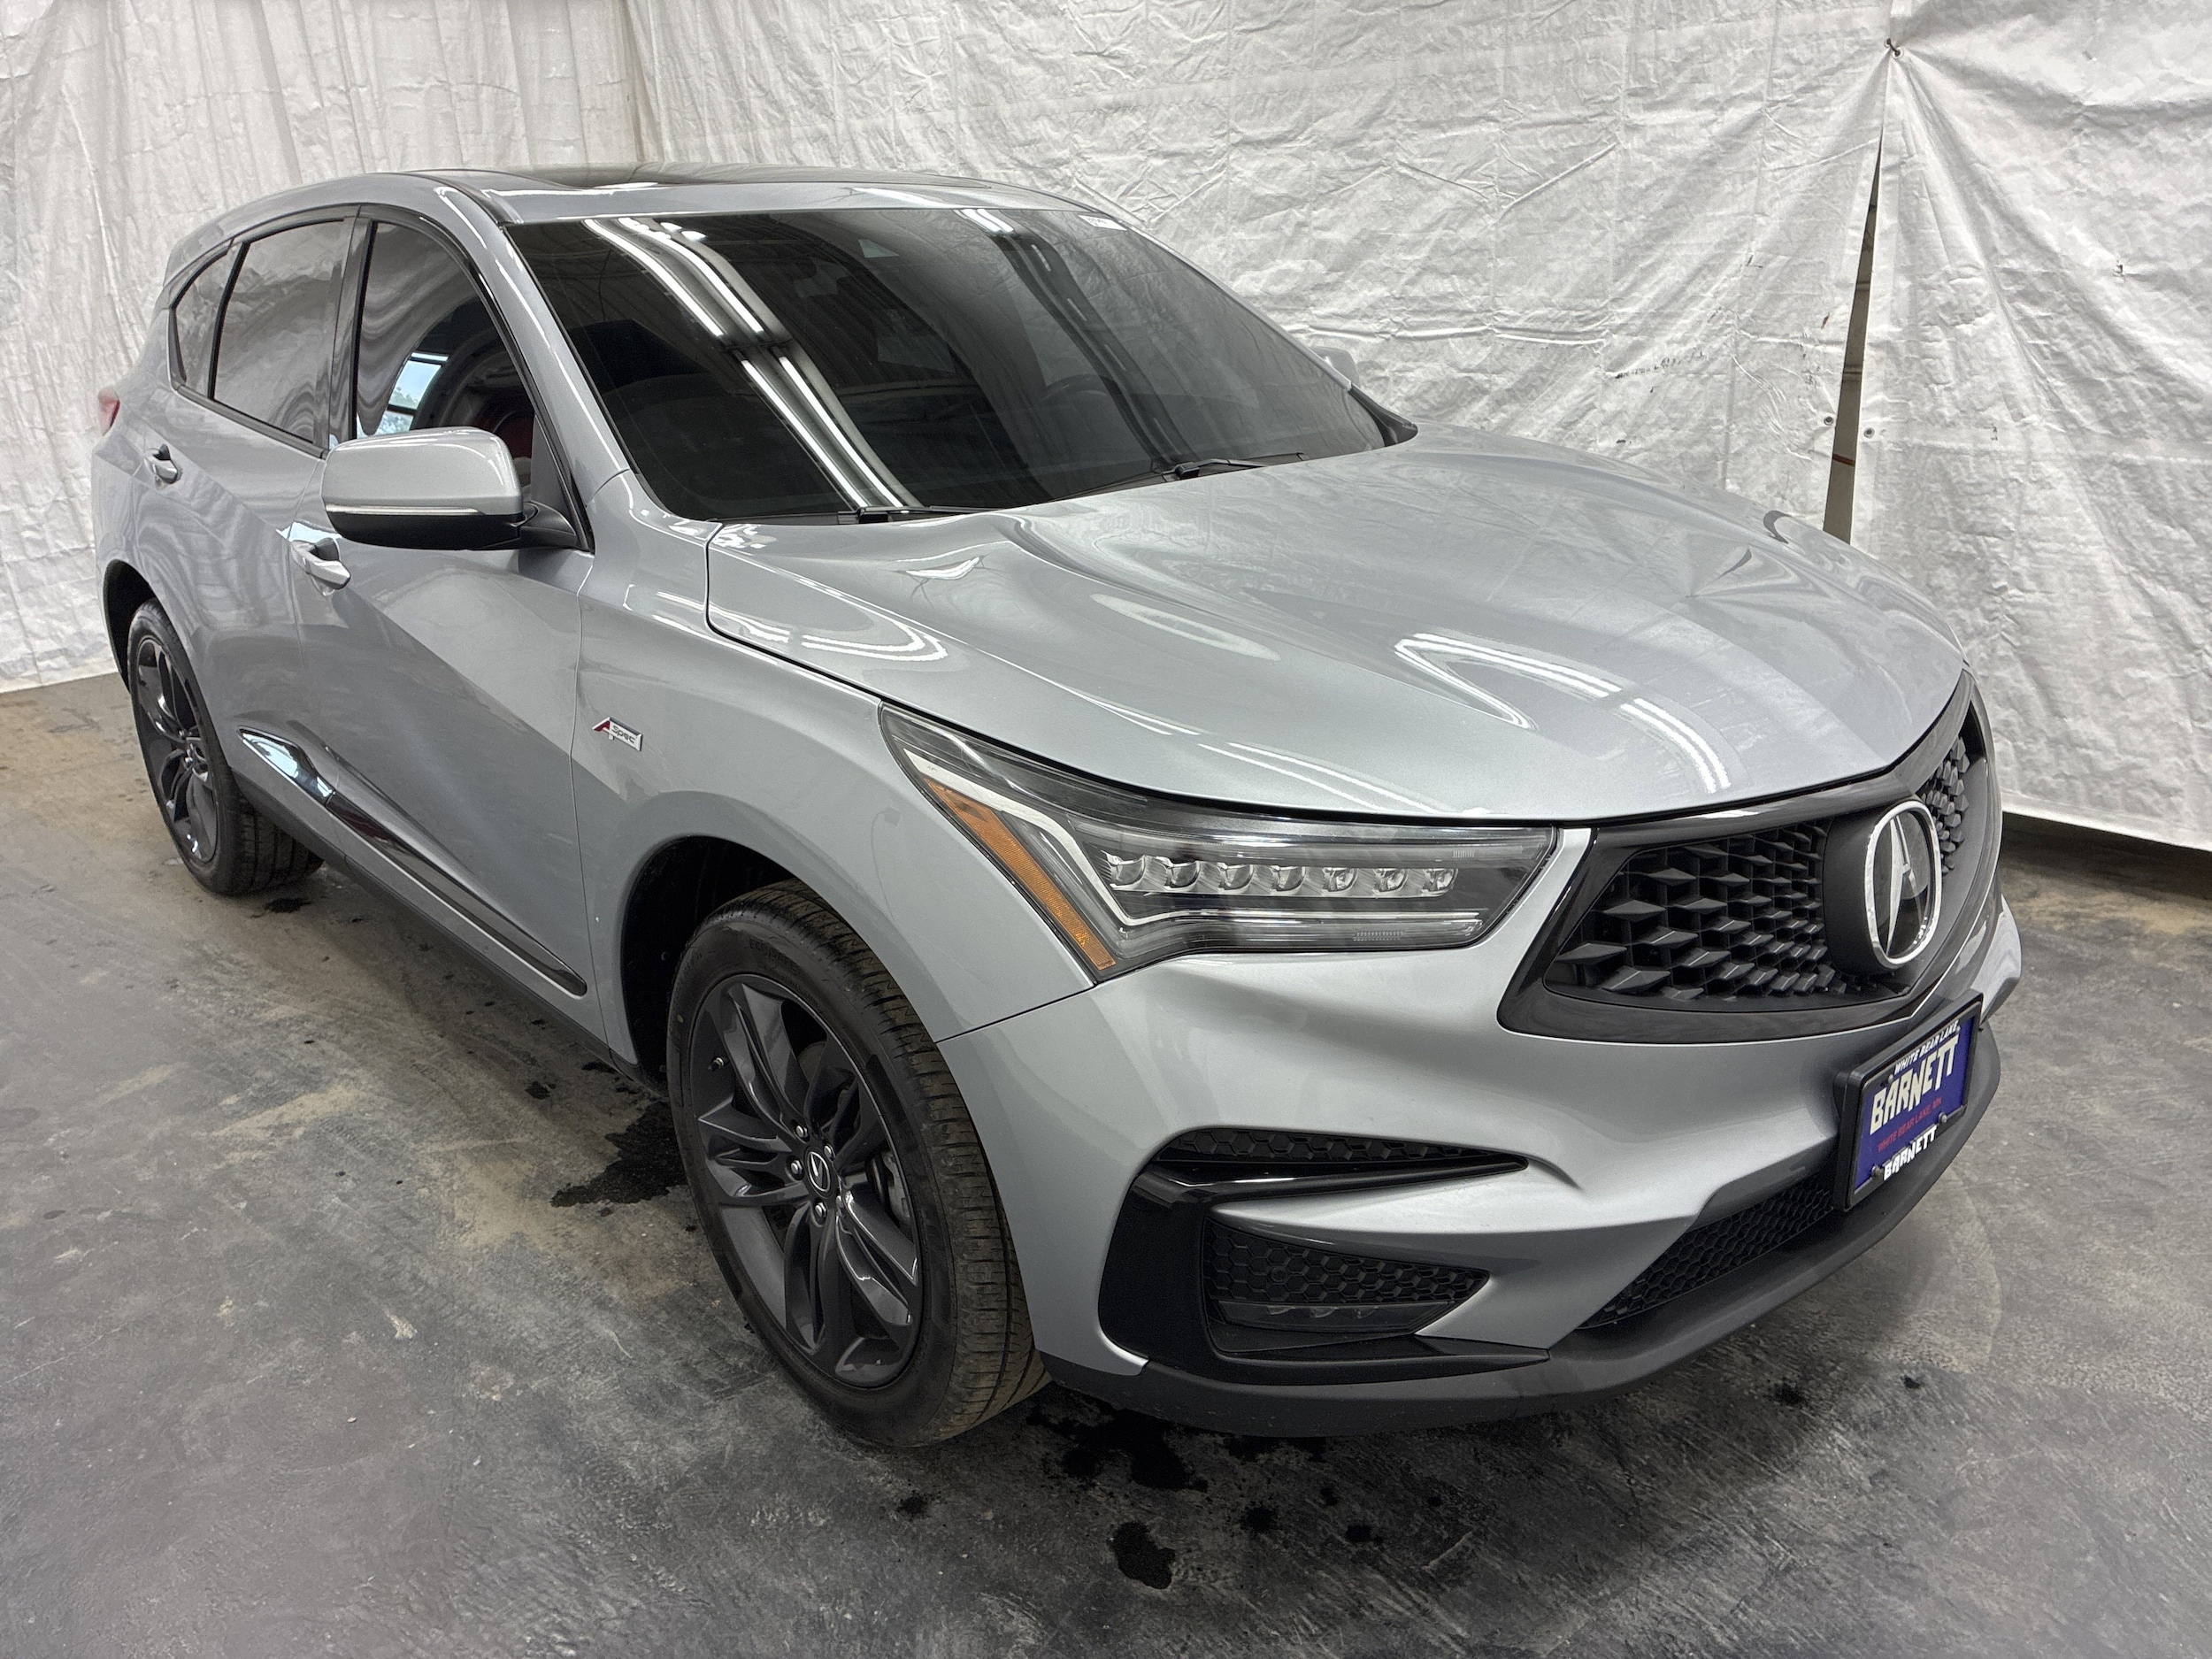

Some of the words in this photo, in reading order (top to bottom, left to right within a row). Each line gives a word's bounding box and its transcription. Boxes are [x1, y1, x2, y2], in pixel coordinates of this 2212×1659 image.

[1894, 1048, 1920, 1075] WHITE
[1919, 1034, 1940, 1058] BEAR
[1939, 1019, 1959, 1043] LAKE
[1870, 1033, 1960, 1136] BARNETT
[1878, 1131, 1898, 1153] WHITE
[1897, 1118, 1916, 1138] BEAR
[1884, 1125, 1938, 1181] BARNETT
